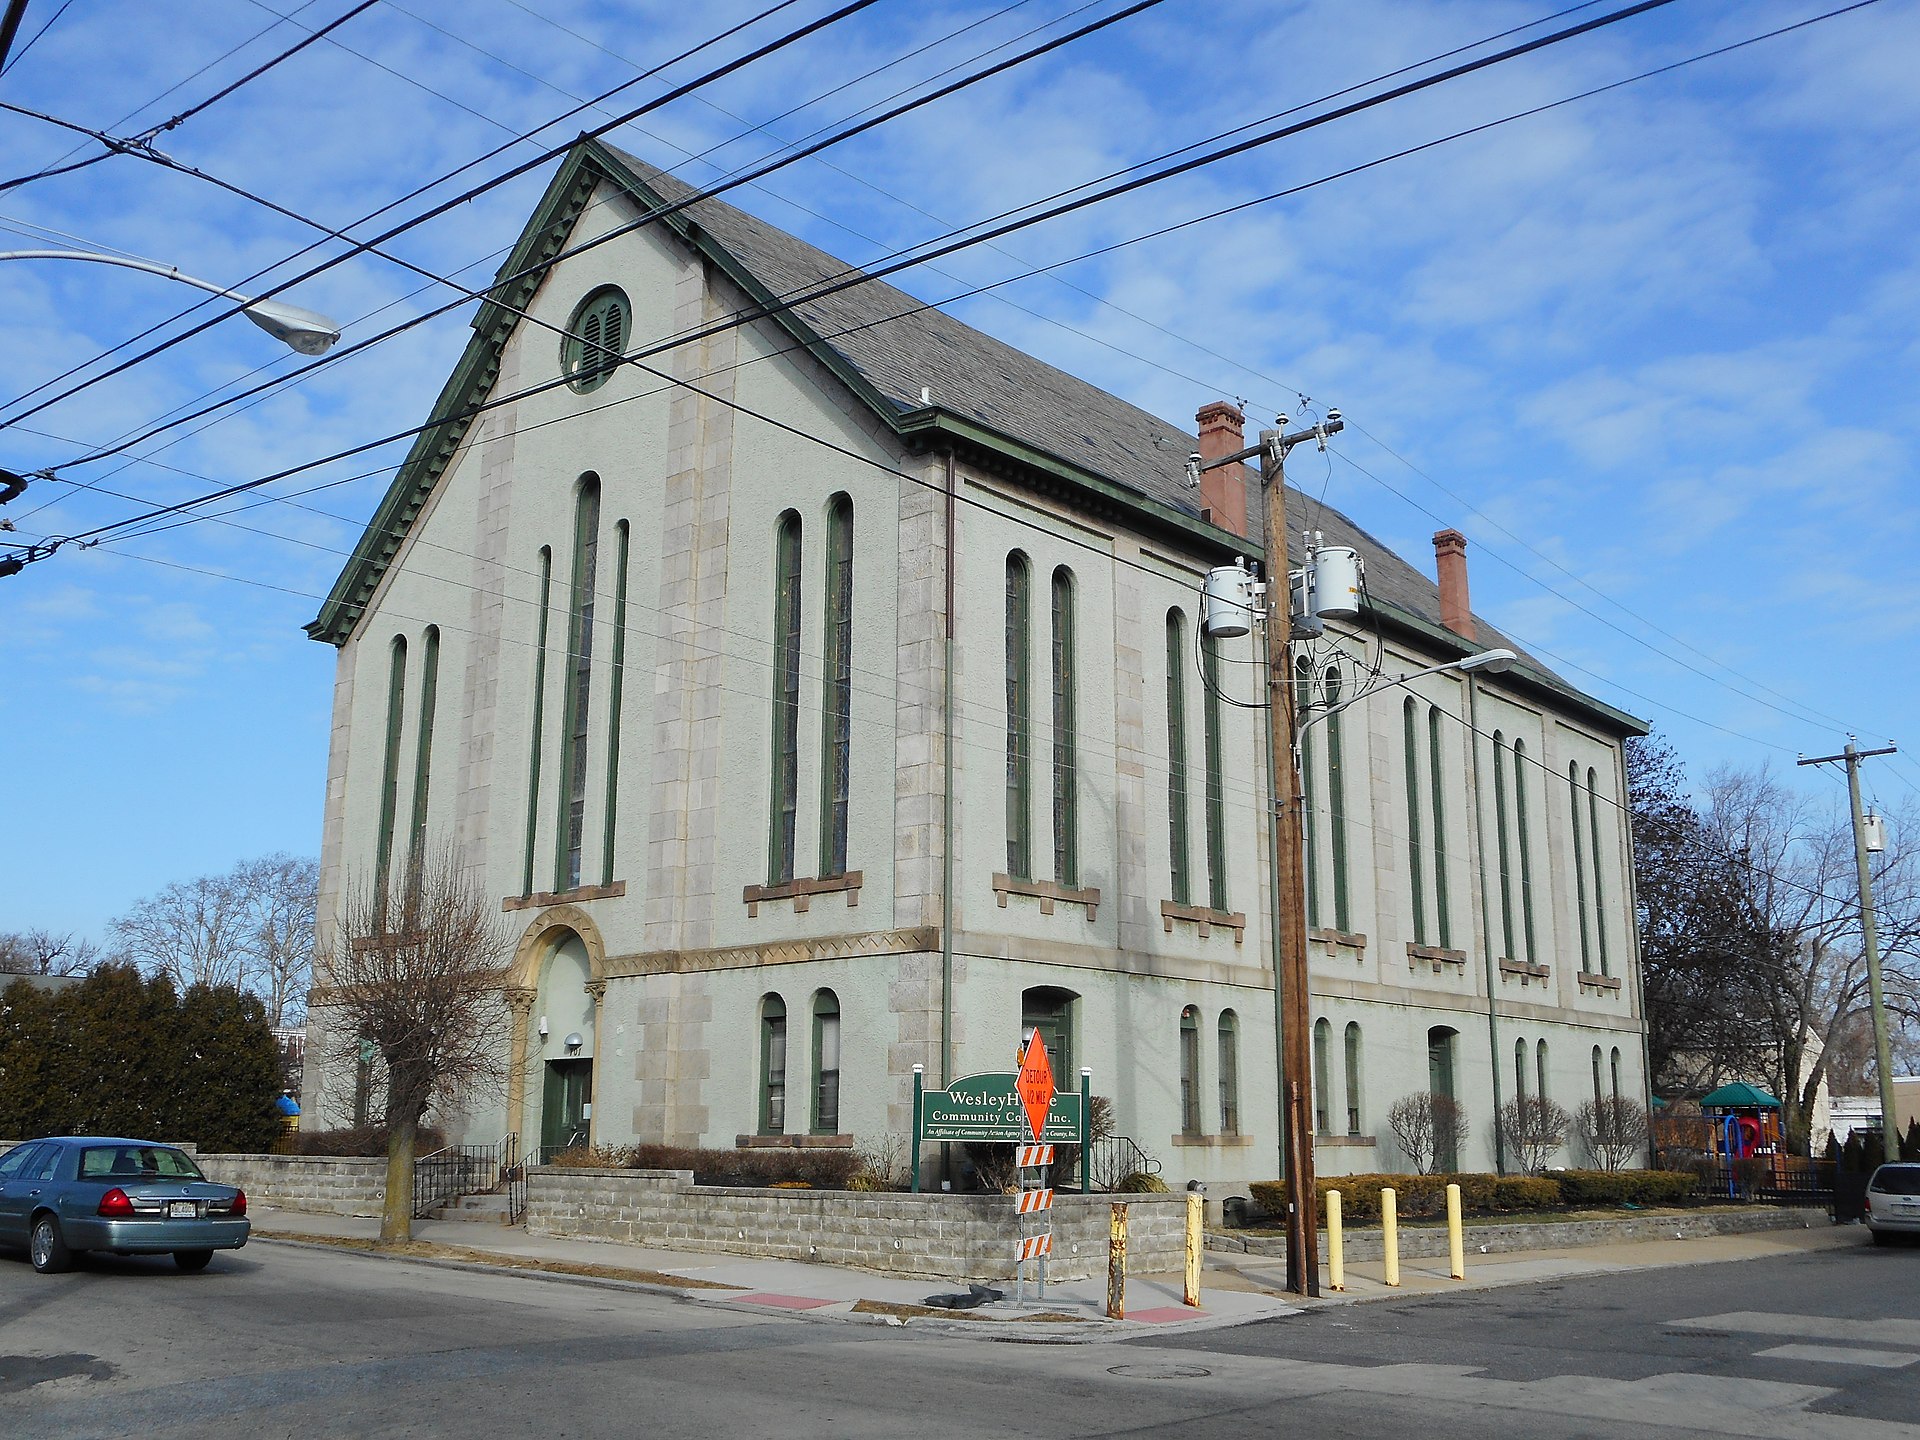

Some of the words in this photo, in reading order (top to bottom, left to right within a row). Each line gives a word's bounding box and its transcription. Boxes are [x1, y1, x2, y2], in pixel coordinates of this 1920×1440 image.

[1025, 1069, 1048, 1084] DETOUR
[949, 1091, 1057, 1111] WesleyHe
[1036, 1090, 1046, 1105] MILE
[932, 1110, 1001, 1125] Community
[1049, 1112, 1071, 1123] Inc.
[955, 1128, 962, 1137] of
[961, 1129, 988, 1138] Community
[1068, 1130, 1078, 1138] Inc.
